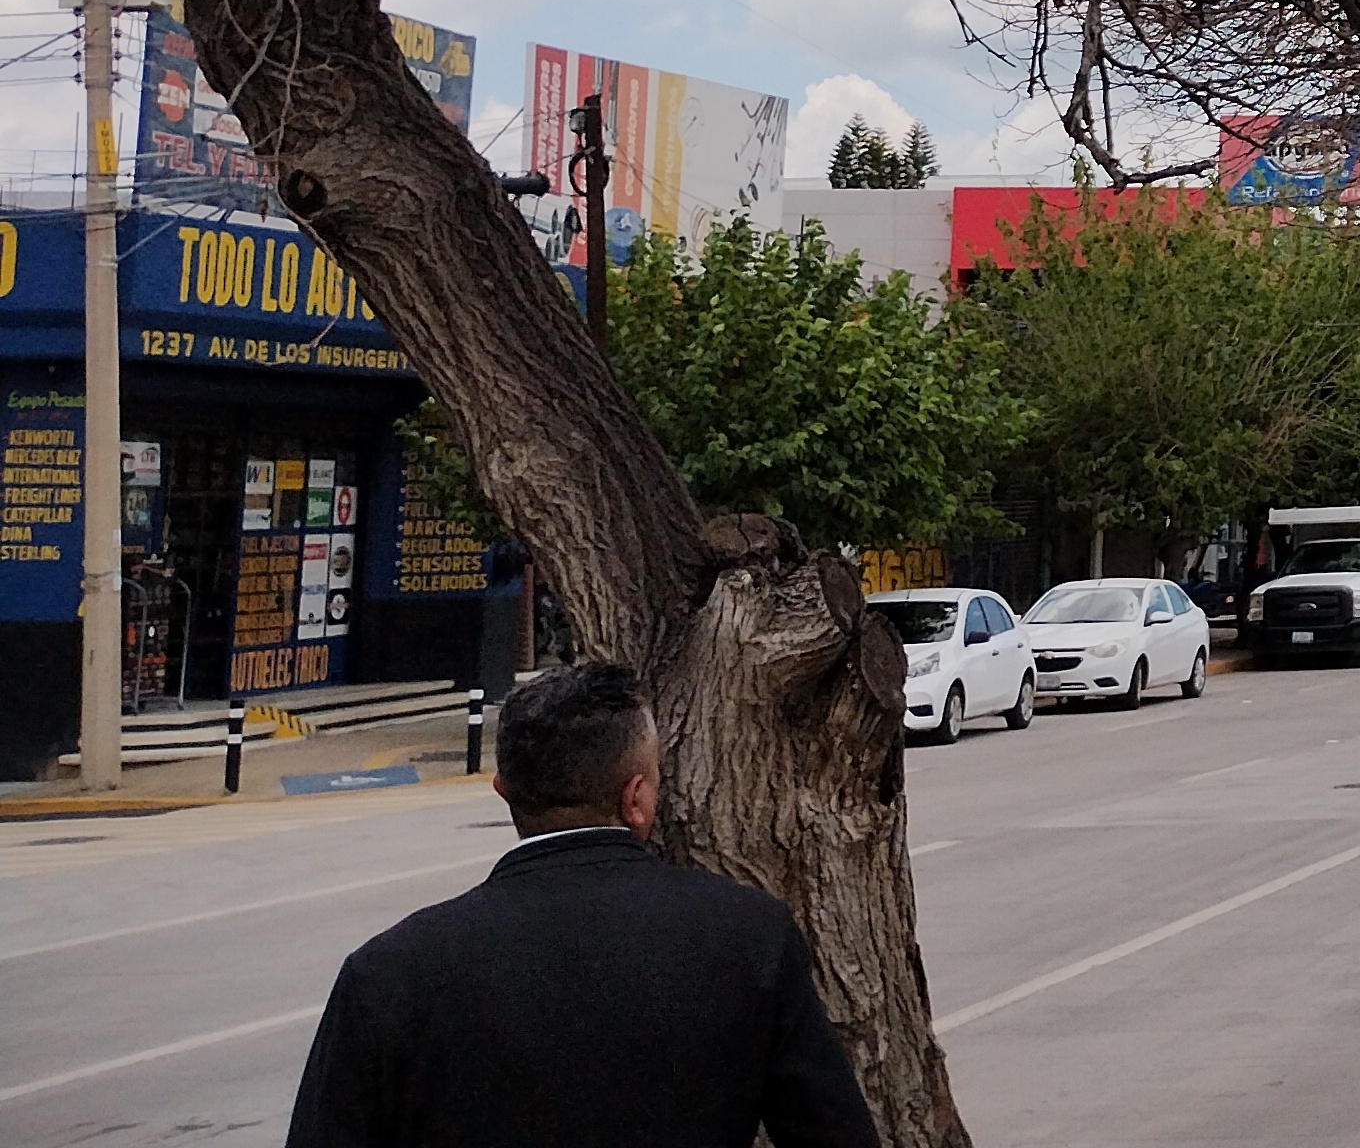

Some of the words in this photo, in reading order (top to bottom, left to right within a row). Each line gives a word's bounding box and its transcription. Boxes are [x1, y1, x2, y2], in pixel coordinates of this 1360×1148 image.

[158, 83, 190, 109] ZEN
[208, 141, 226, 176] Y
[178, 226, 255, 308] TODO
[261, 238, 300, 314] LO
[141, 329, 195, 358] 1237
[209, 336, 238, 359] AV.
[245, 339, 268, 362] DE
[275, 342, 310, 364] LOS
[9, 429, 75, 446] KENWORTH
[3, 467, 81, 485] INTERNATIONAL
[5, 487, 54, 504] FREIGHT
[4, 507, 73, 523] CATERPILLAR
[1, 526, 32, 542] DINA
[0, 545, 61, 561] STERLING
[400, 555, 482, 573] SENSORES
[399, 573, 488, 592] SOLENOIDES
